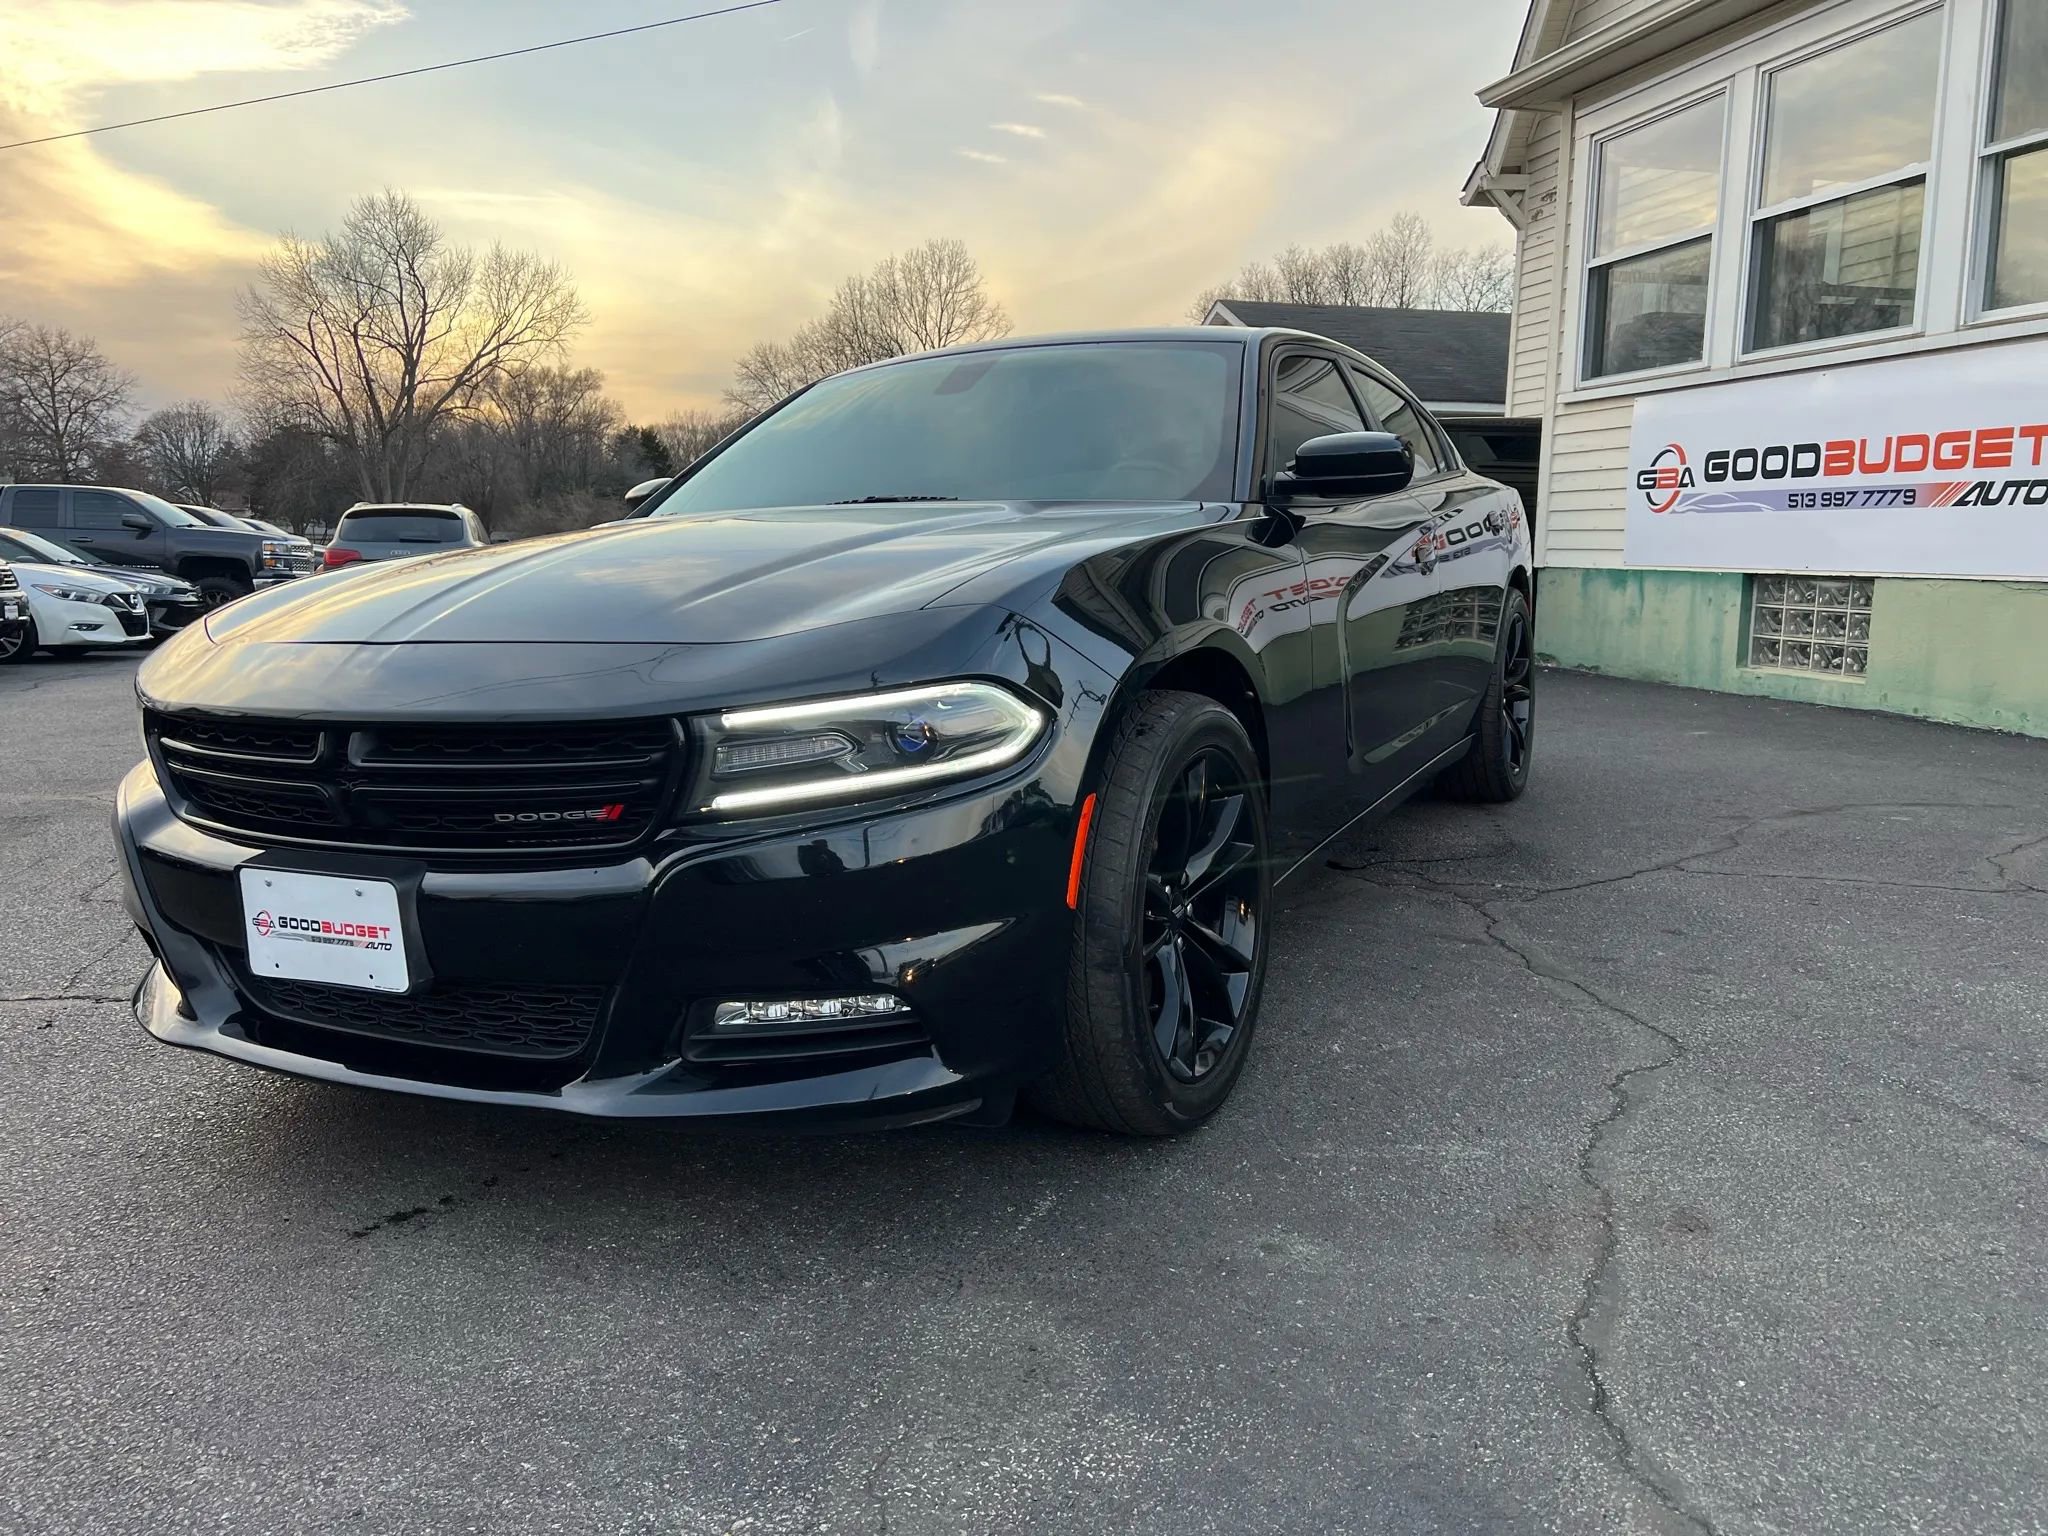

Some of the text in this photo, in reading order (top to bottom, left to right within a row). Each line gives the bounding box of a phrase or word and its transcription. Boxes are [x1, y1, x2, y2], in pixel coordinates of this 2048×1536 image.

[1636, 467, 1696, 490] GBA
[1787, 488, 1917, 508] 513 997 7779
[1950, 478, 2048, 507] AUTO
[494, 809, 609, 822] DODGE
[278, 916, 391, 940] GOODBUDGET
[365, 941, 391, 951] AUTO
